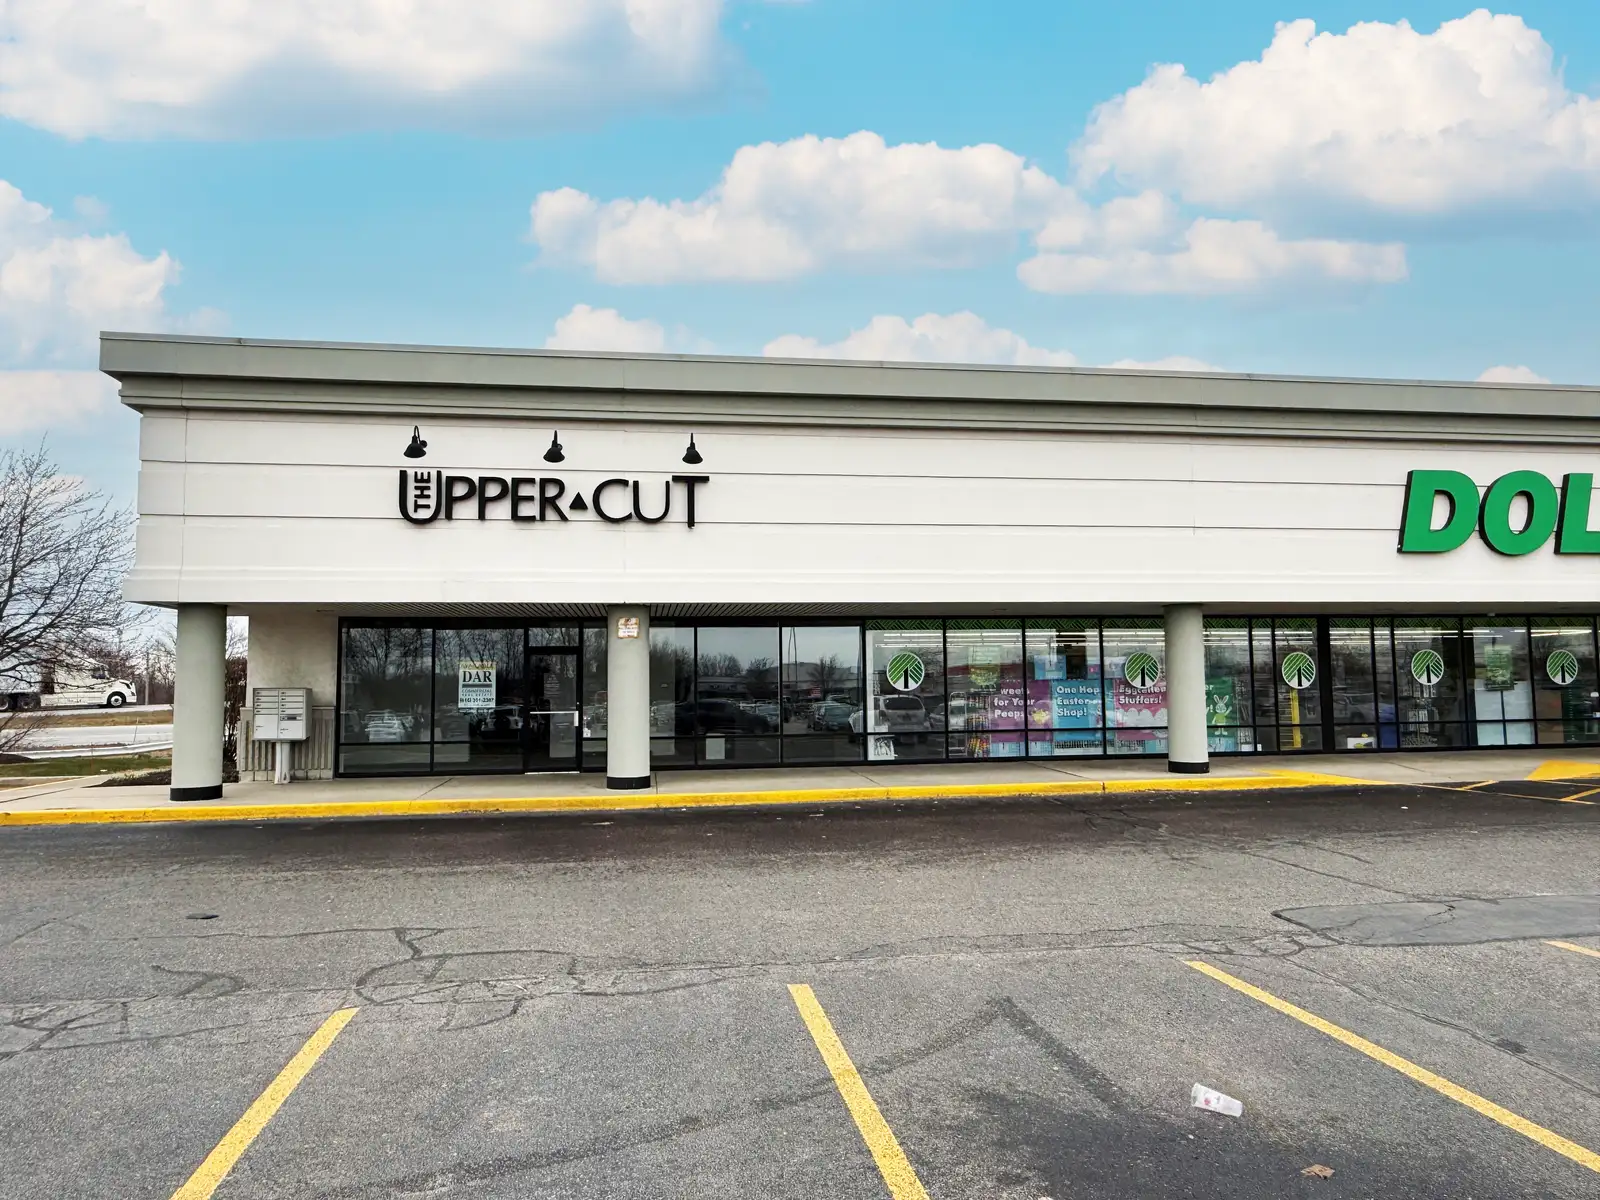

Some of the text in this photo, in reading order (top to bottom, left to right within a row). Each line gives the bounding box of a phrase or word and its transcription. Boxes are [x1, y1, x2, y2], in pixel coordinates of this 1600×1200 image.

[413, 470, 432, 513] THE
[398, 470, 710, 530] UPPER CUT
[462, 670, 493, 683] DAR
[1056, 685, 1100, 695] One Hop
[1118, 684, 1167, 695] Eggcellen
[993, 697, 1009, 706] for
[1057, 696, 1090, 705] Easter
[1118, 695, 1162, 704] Stuffers!
[1057, 707, 1087, 718] Shop!
